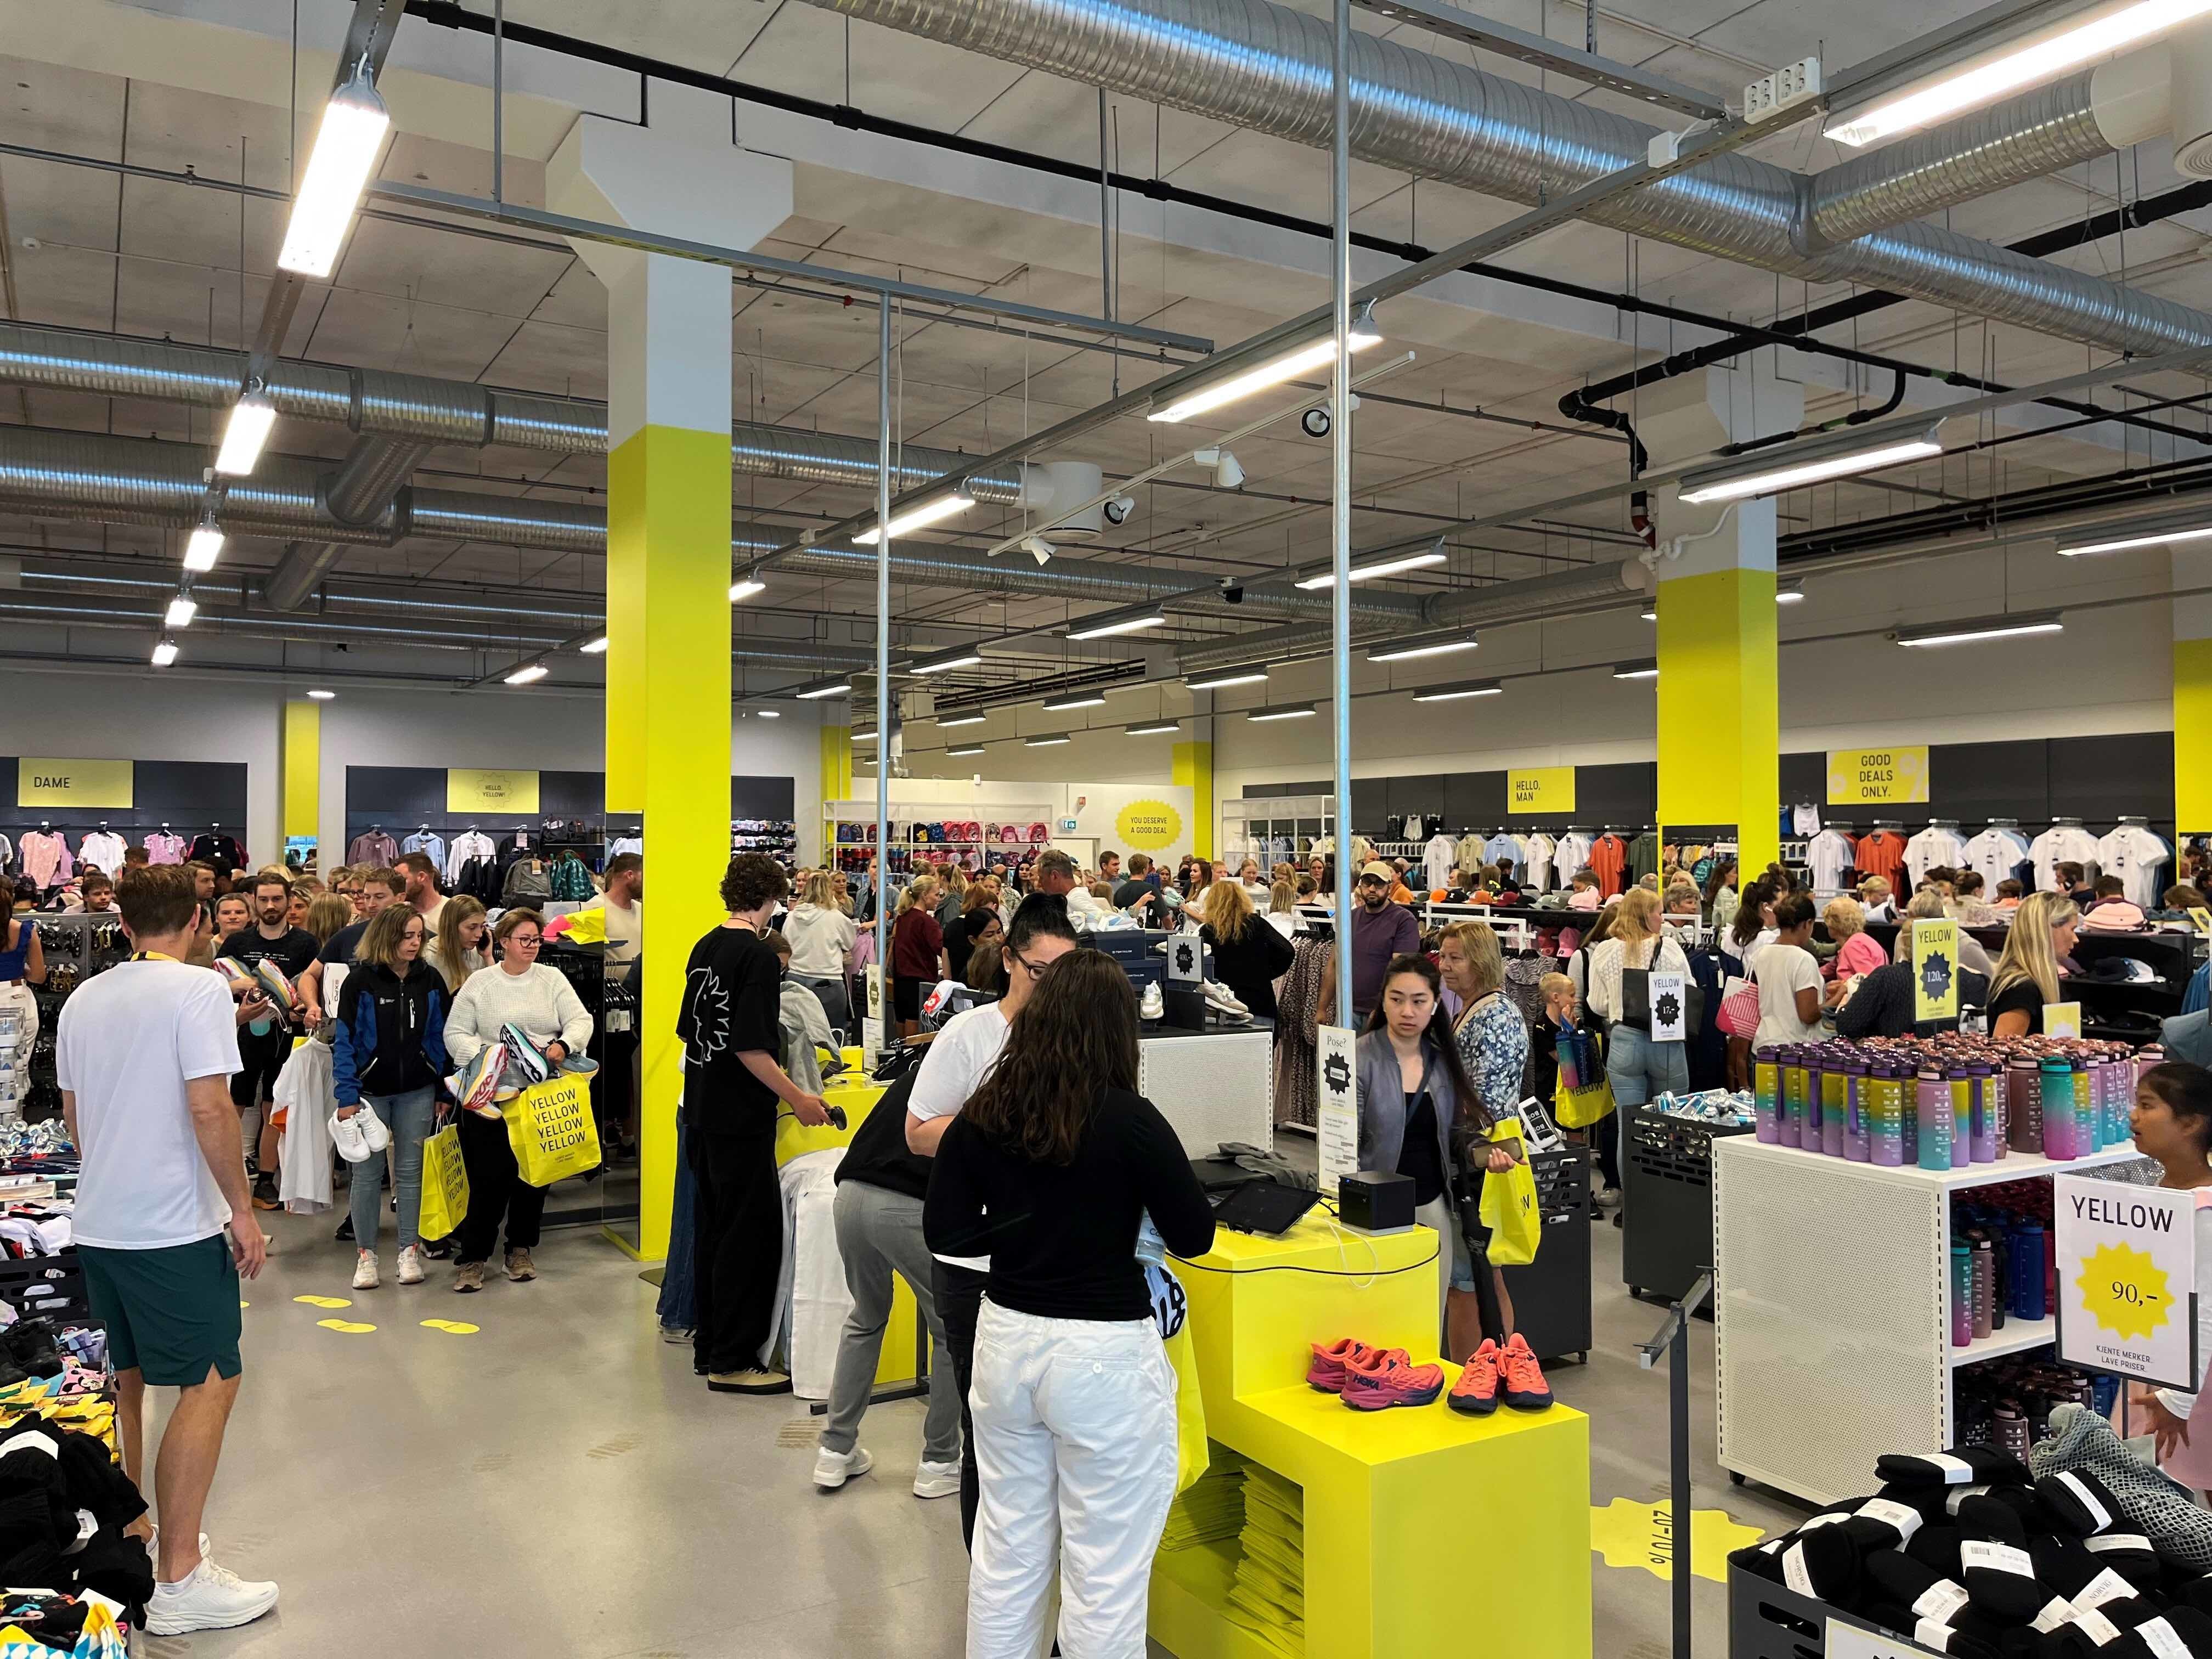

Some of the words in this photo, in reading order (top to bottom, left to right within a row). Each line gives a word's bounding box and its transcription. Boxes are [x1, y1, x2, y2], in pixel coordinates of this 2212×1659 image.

[1861, 754, 1891, 766] GOOD
[34, 776, 71, 788] DAME
[1860, 770, 1893, 782] DEALS
[1516, 780, 1541, 791] HELLO,
[1861, 786, 1891, 798] ONLY.
[1516, 792, 1533, 802] MAN
[1918, 929, 1952, 944] YELLOW
[1927, 970, 1947, 983] 120,-
[1654, 979, 1680, 988] YELLOW
[1327, 1035, 1347, 1048] Pose?
[530, 1088, 575, 1110] YELLOW
[534, 1102, 579, 1125] YELLOW
[537, 1116, 582, 1139] YELLOW
[540, 1130, 585, 1153] YELLOW
[2072, 1195, 2173, 1233] YELLOW
[2112, 1281, 2157, 1307] 90,-
[2096, 1345, 2121, 1357] KJENTE
[2101, 1356, 2119, 1367] LAVE
[1352, 1374, 1380, 1390] HOKA
[2089, 1579, 2112, 1601] NORVIG
